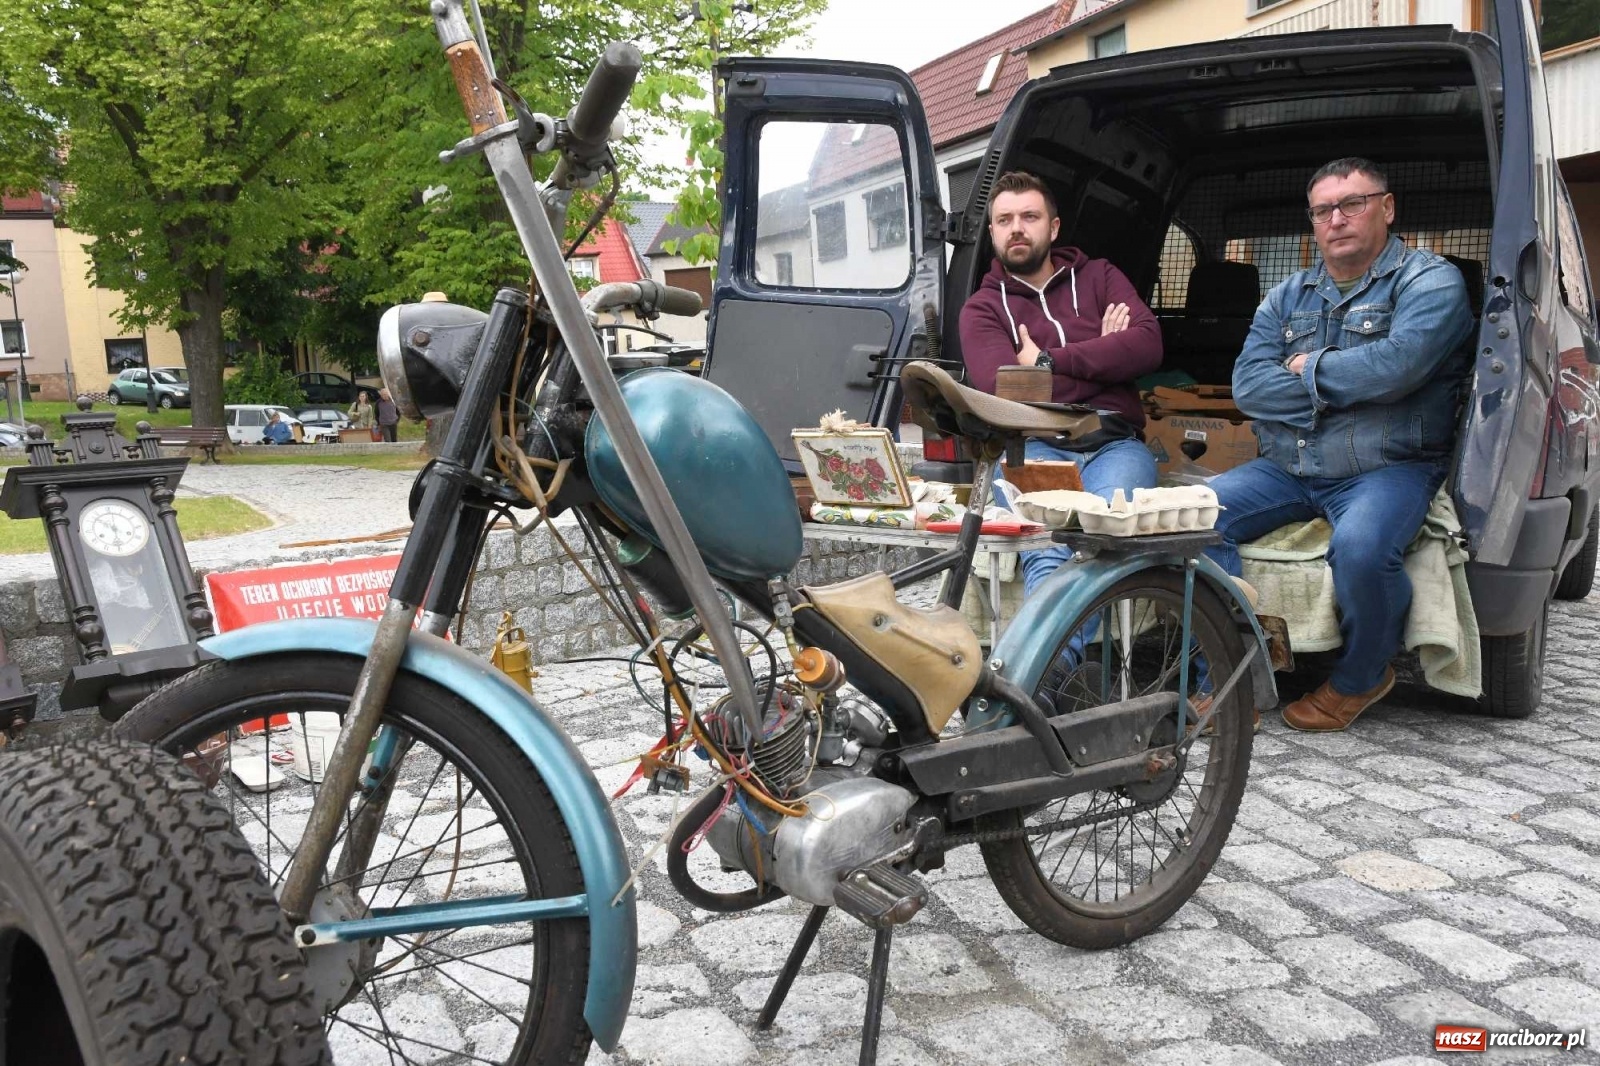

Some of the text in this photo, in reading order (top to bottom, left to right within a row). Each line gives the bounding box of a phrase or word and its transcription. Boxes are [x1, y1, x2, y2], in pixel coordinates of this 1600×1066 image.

[1170, 419, 1225, 431] BANANAS
[239, 568, 398, 605] TEREN OCHRONY BEZPOŚRED
[350, 592, 390, 614] WOD
